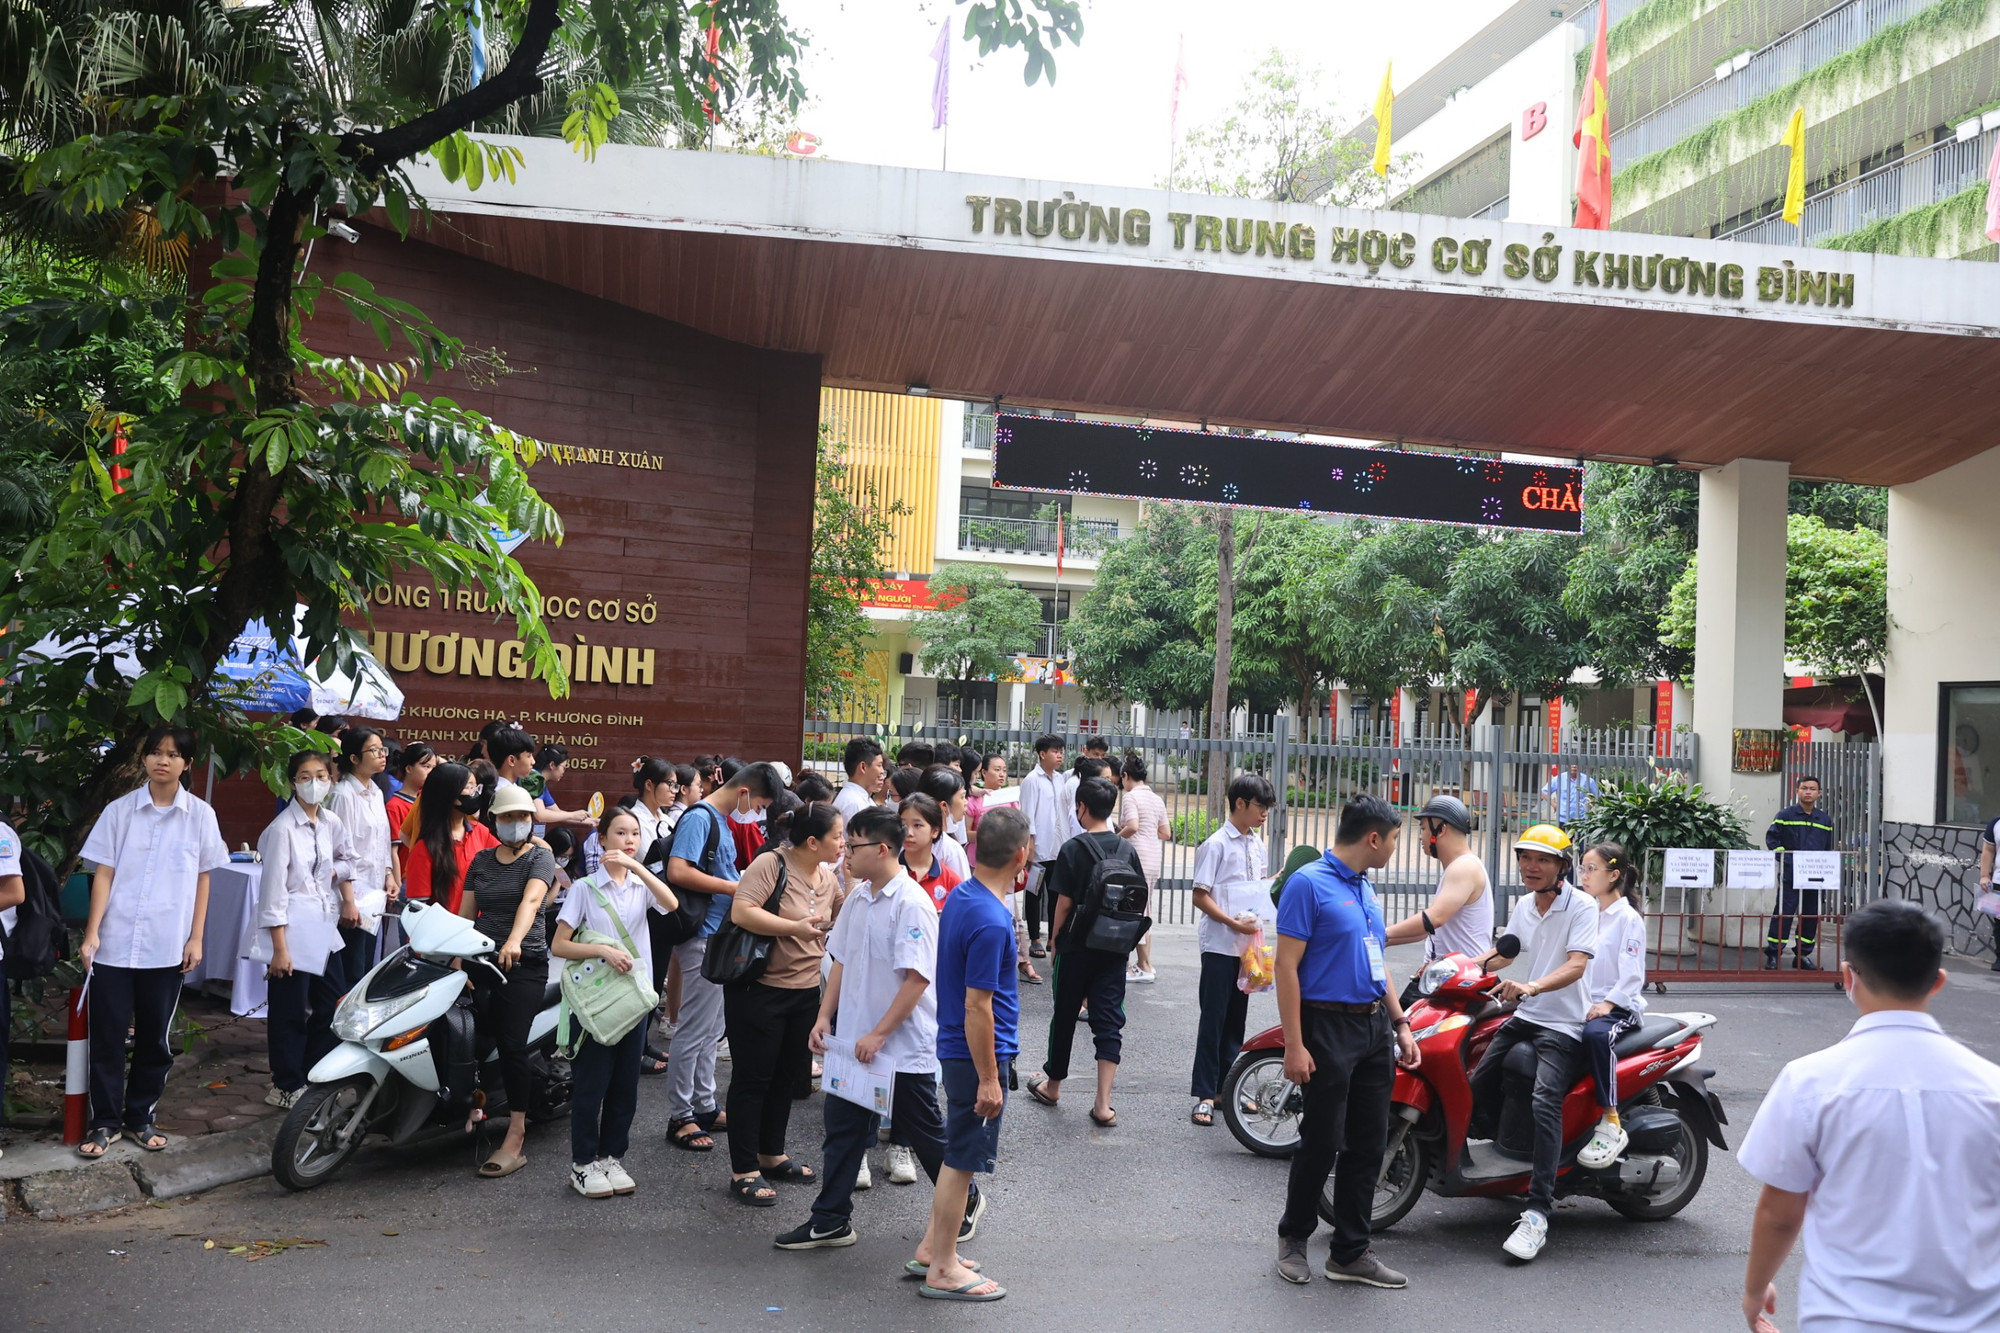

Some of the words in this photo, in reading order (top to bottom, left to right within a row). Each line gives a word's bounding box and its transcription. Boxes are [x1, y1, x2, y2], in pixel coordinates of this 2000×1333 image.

[1522, 101, 1547, 142] B
[787, 131, 818, 155] C
[966, 191, 1151, 246] TRƯỜNG
[1168, 212, 1316, 260] TRUNG
[1332, 226, 1416, 274] HỌC
[1432, 236, 1491, 275] CƠ
[1504, 231, 1563, 282] SỞ
[1574, 250, 1743, 299] KHƯƠNG
[1756, 260, 1855, 309] ĐÌNH
[617, 450, 663, 470] XUÂN
[587, 599, 621, 622] CƠ
[625, 593, 658, 624] SỞ
[358, 629, 528, 679] HƯƠNG
[409, 706, 480, 720] KHƯƠNG
[535, 711, 602, 725] KHƯƠNG
[607, 712, 643, 726] ĐÌNH
[396, 728, 454, 741] THANH
[543, 731, 566, 745] HÀ
[571, 733, 598, 747] NỘI
